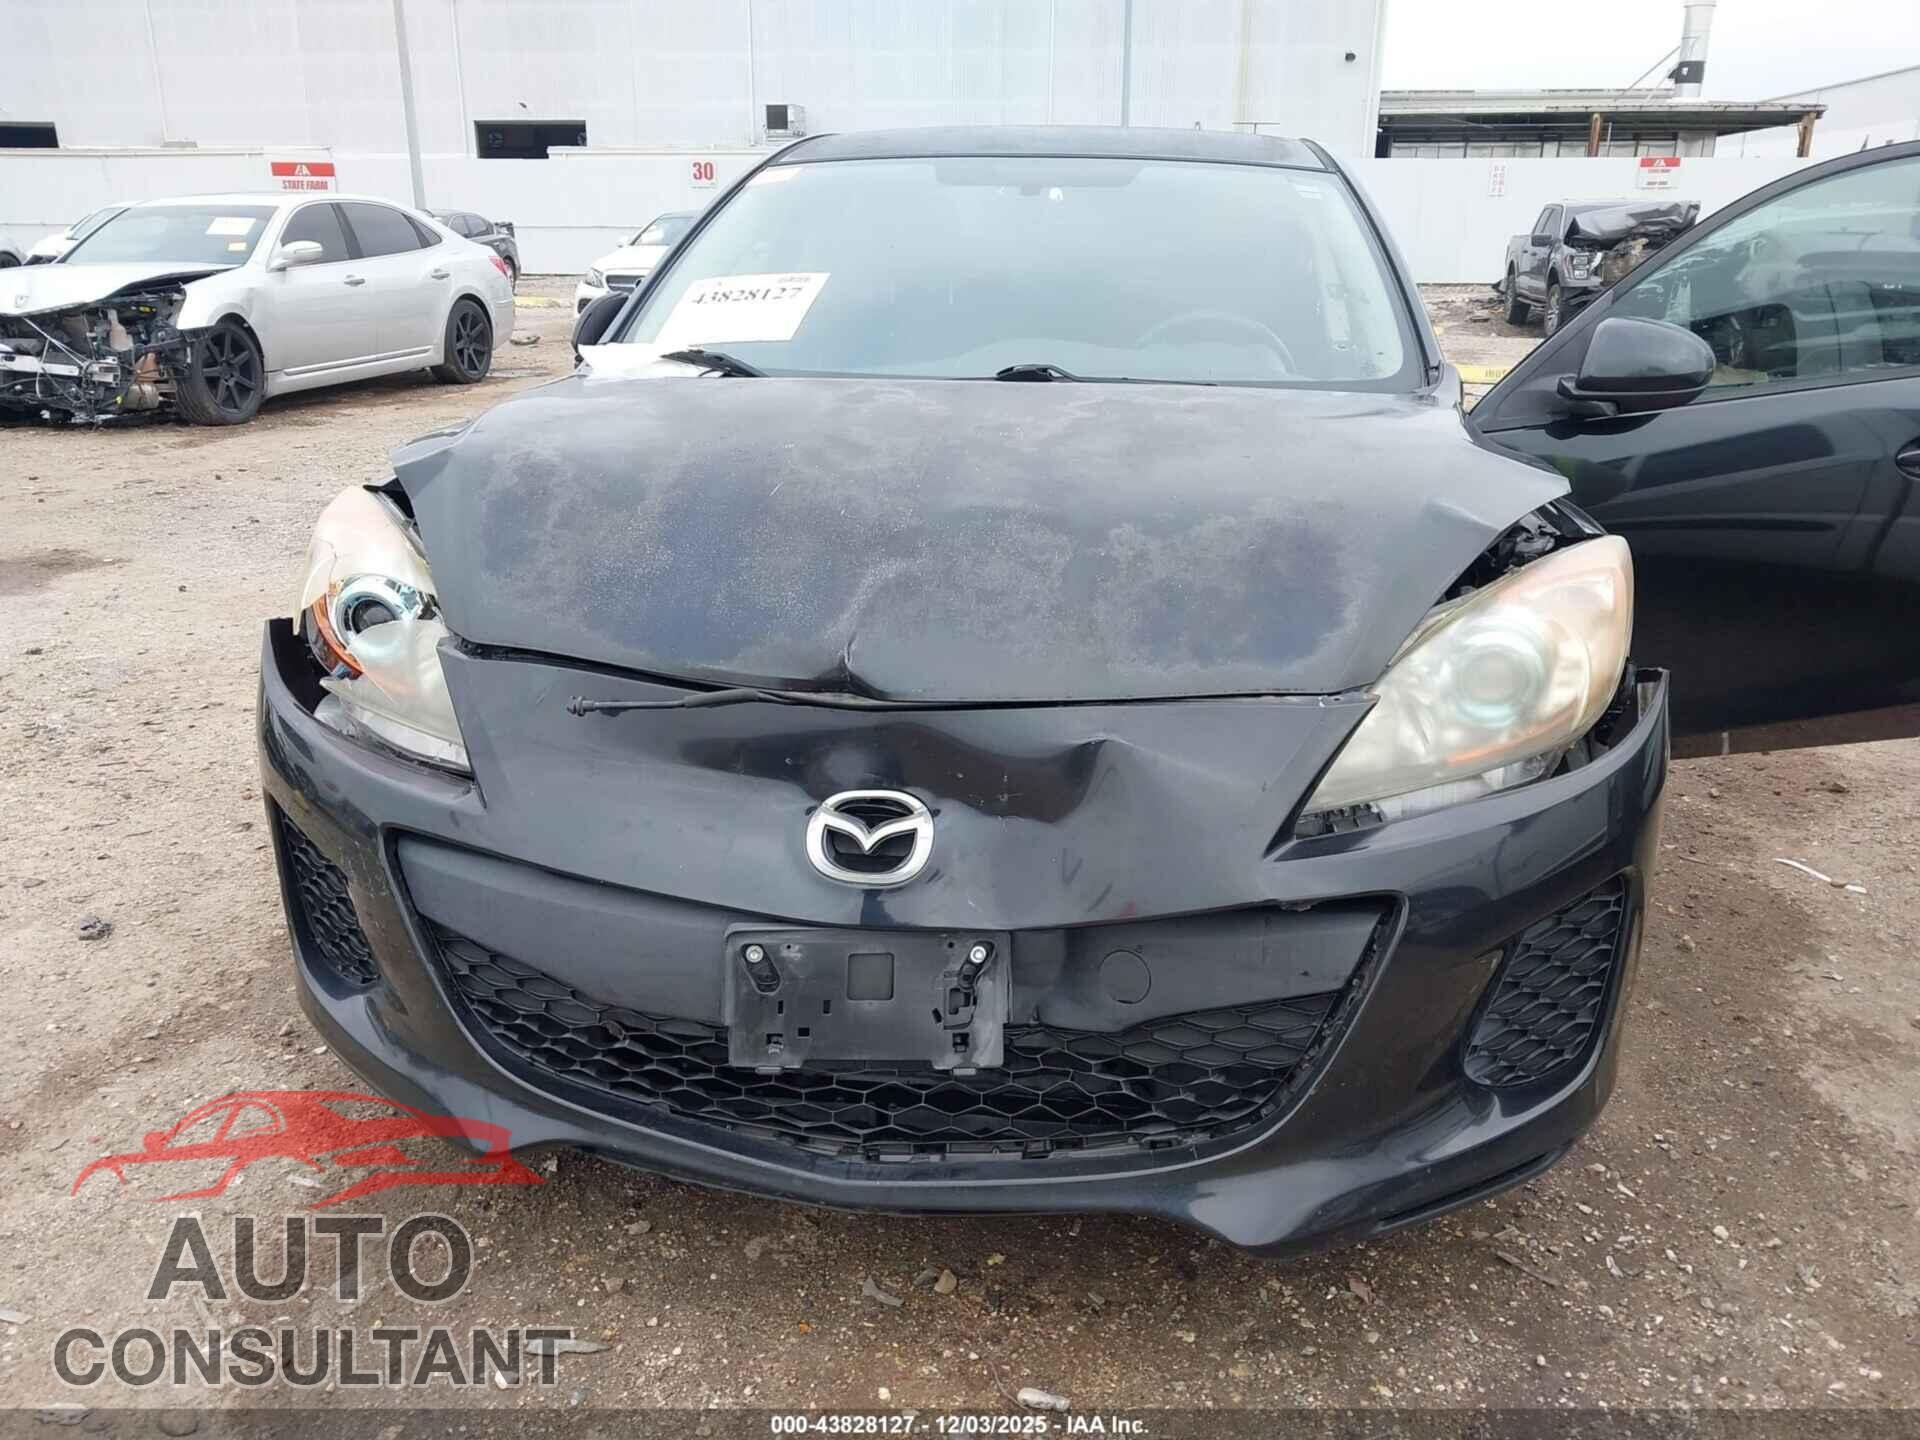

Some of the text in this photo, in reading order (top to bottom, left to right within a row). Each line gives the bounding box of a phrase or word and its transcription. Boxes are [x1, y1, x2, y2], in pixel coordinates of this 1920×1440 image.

[692, 162, 714, 181] 30
[282, 180, 329, 191] STATE FARM
[692, 286, 803, 304] 43828127
